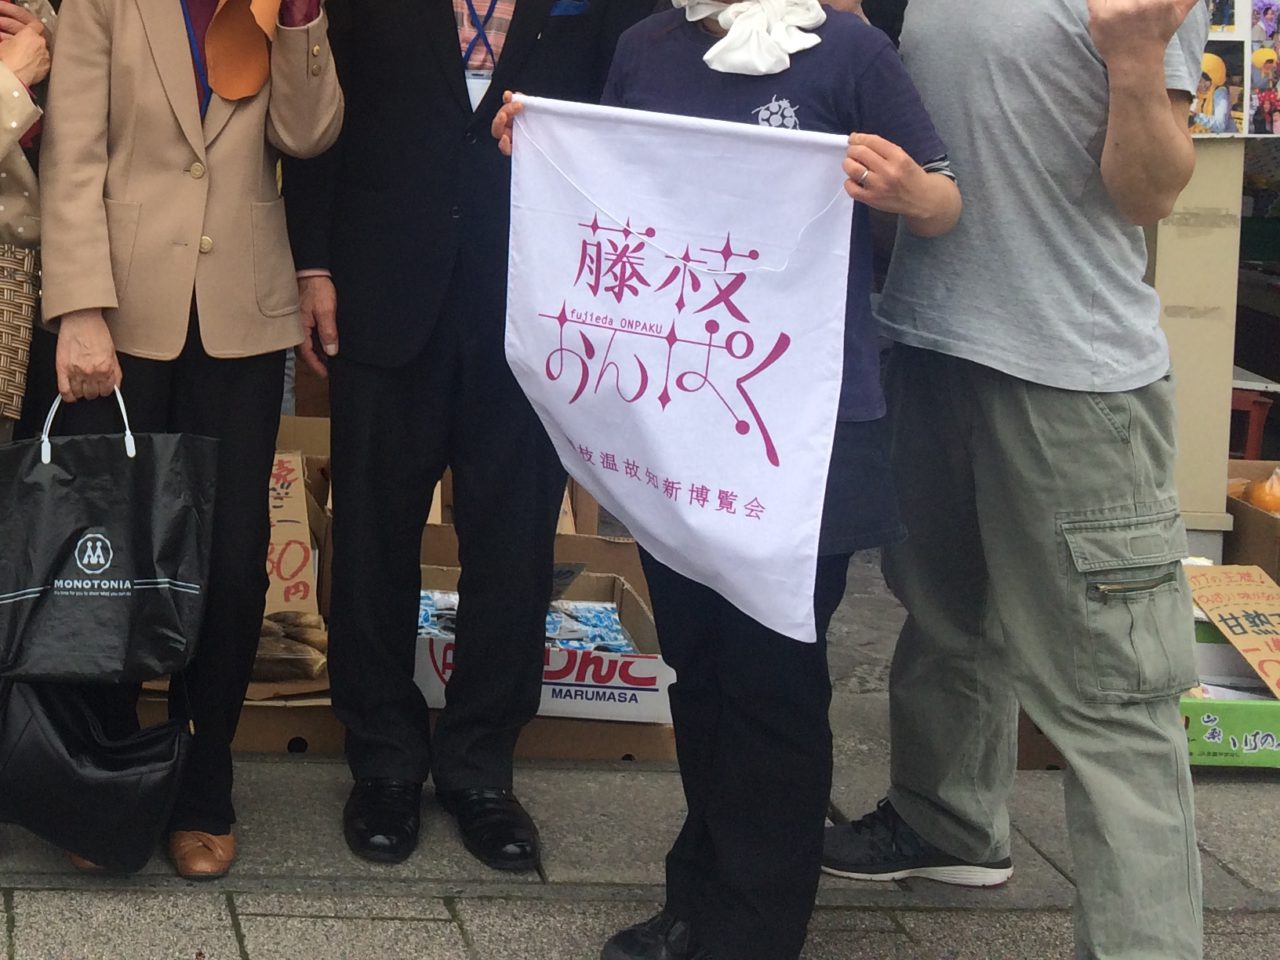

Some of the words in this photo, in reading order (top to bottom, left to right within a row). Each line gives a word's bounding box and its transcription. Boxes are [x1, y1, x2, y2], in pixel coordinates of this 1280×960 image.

[574, 213, 760, 323] 藤枝
[570, 308, 614, 326] fujieda
[619, 318, 664, 335] ONPAKU
[539, 299, 791, 468] おんぱく
[567, 440, 766, 520] 枝温故知新博覧会
[53, 579, 132, 589] MONOTONIA
[551, 687, 639, 704] MARUMASA
[1230, 730, 1280, 753] いちの
